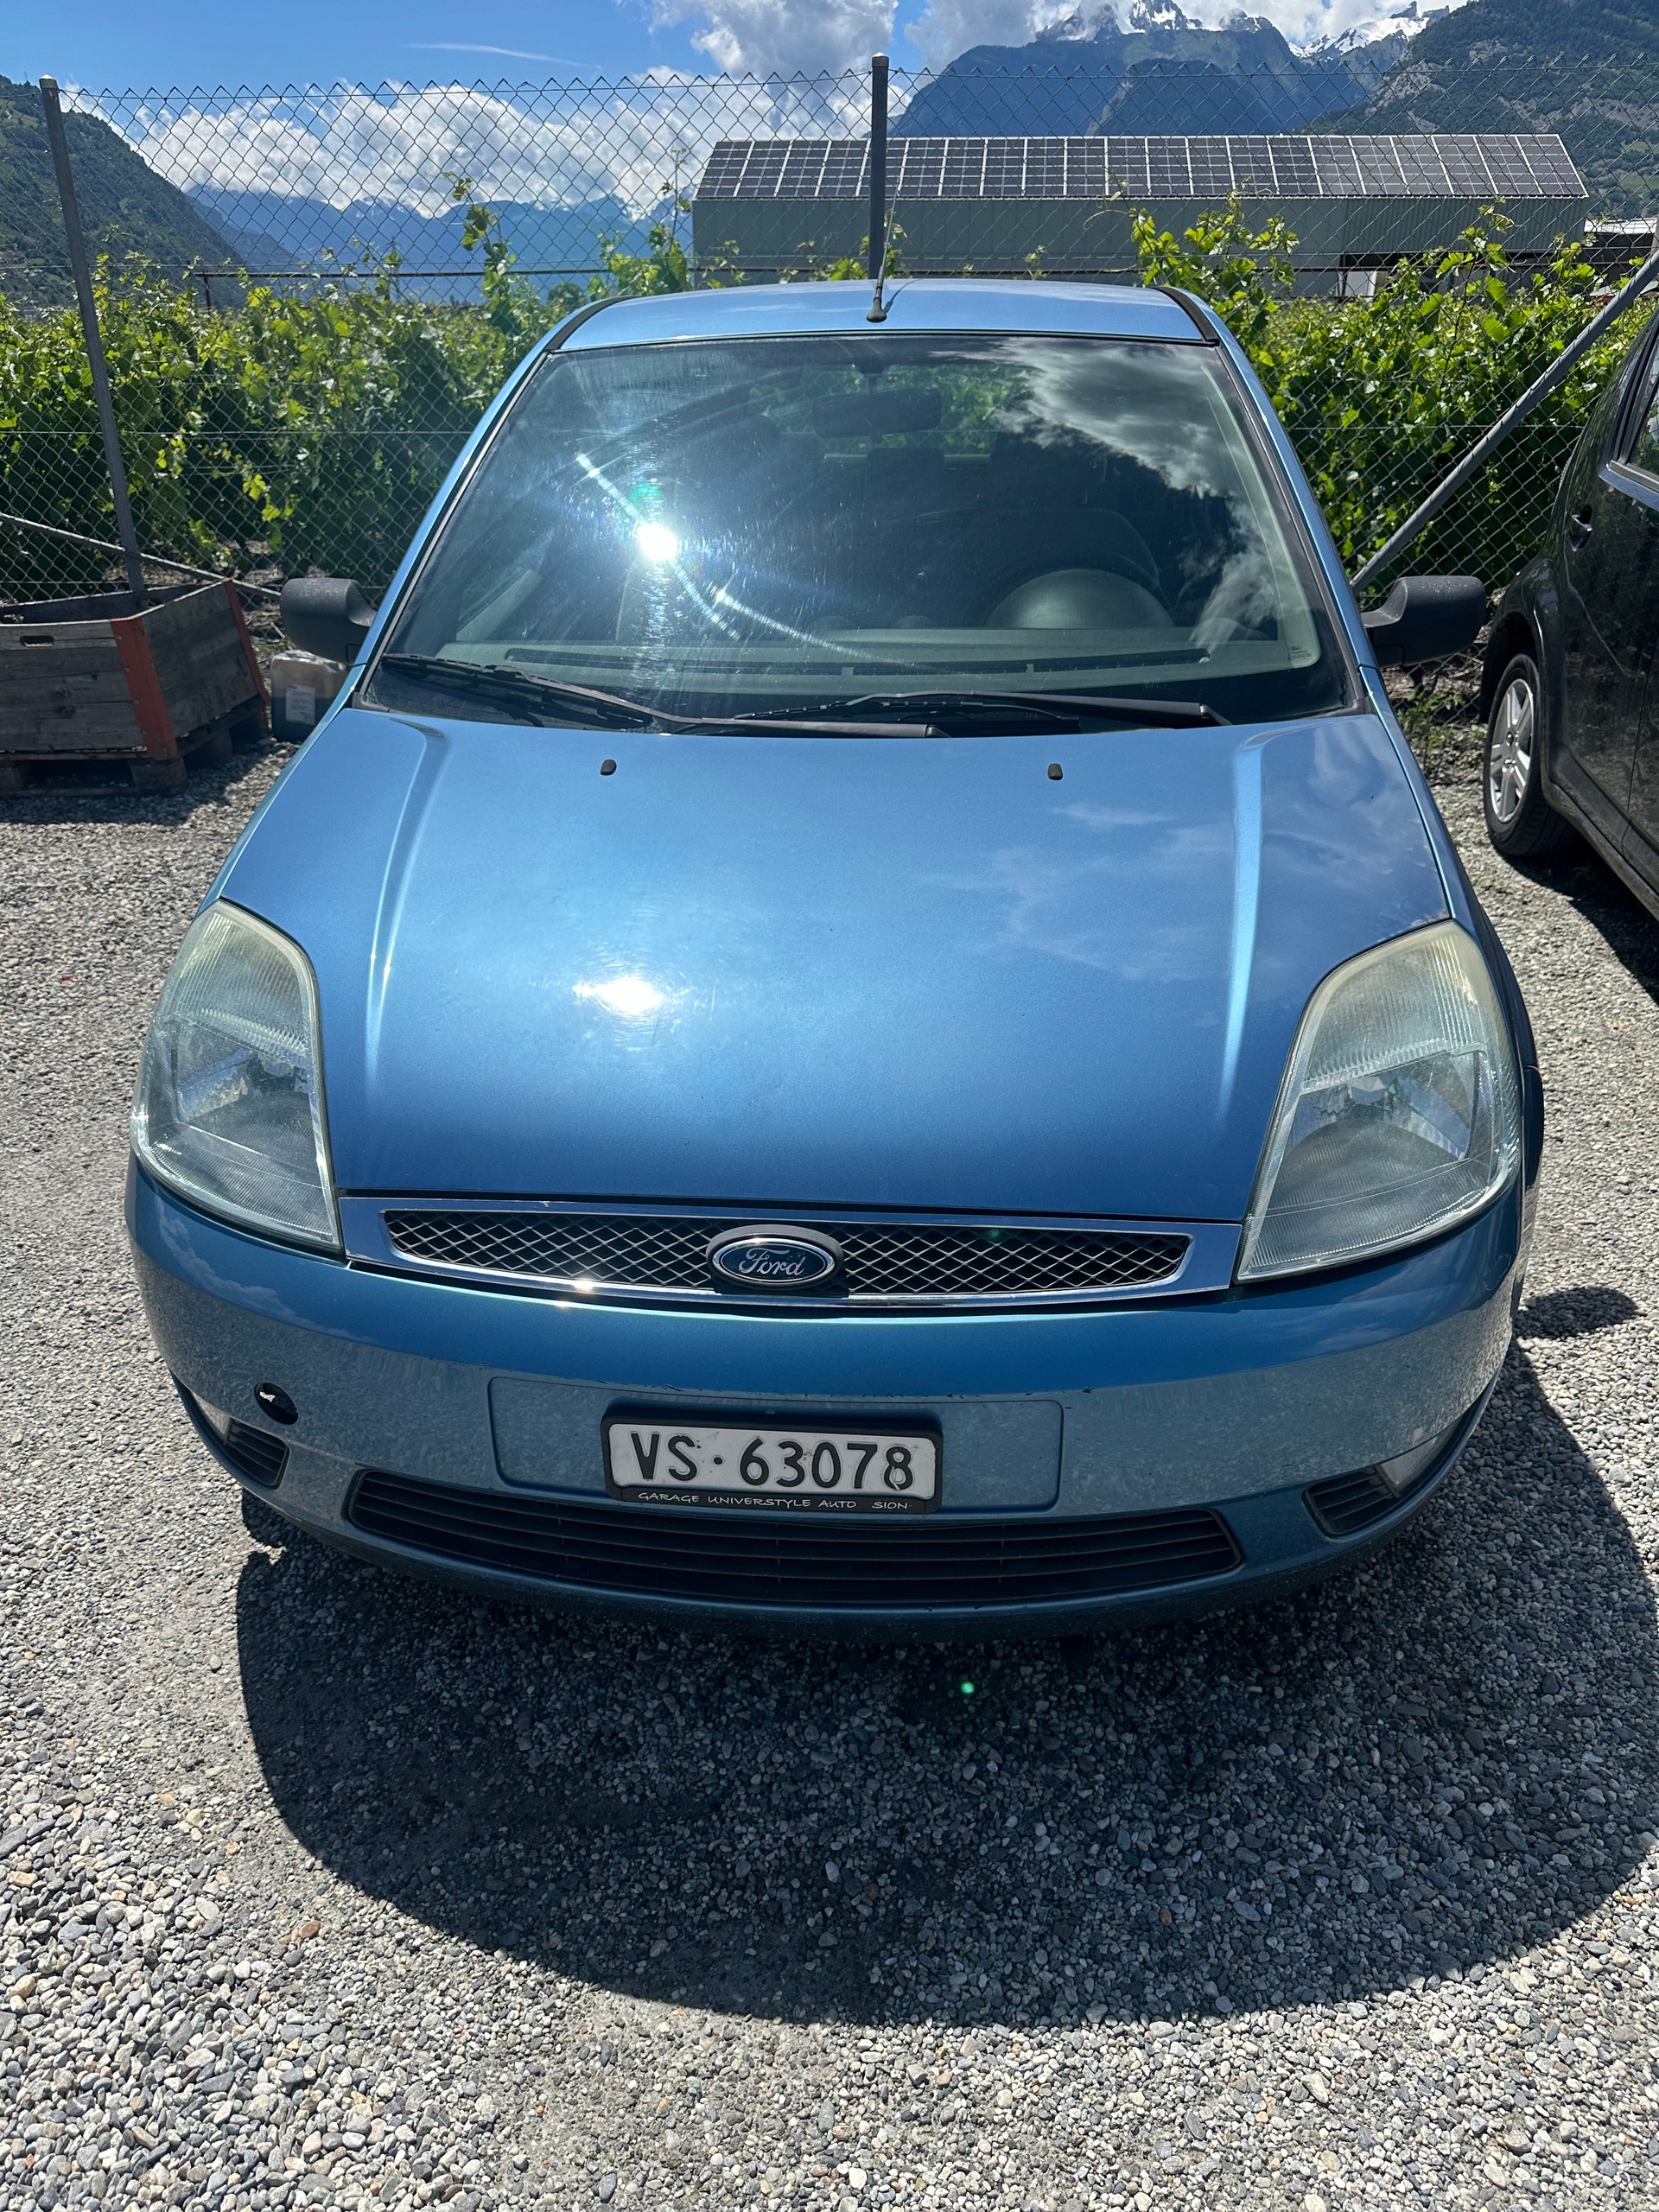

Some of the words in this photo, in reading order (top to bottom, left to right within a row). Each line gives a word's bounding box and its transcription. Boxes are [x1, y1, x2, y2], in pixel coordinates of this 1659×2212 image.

[739, 1248, 807, 1276] Ford
[631, 1433, 697, 1481] VS
[740, 1438, 913, 1491] 63078
[639, 1491, 700, 1503] GARAGE
[708, 1496, 811, 1510] UNIVERSTYLE
[818, 1500, 856, 1510] AUTO
[871, 1502, 908, 1510] SION
